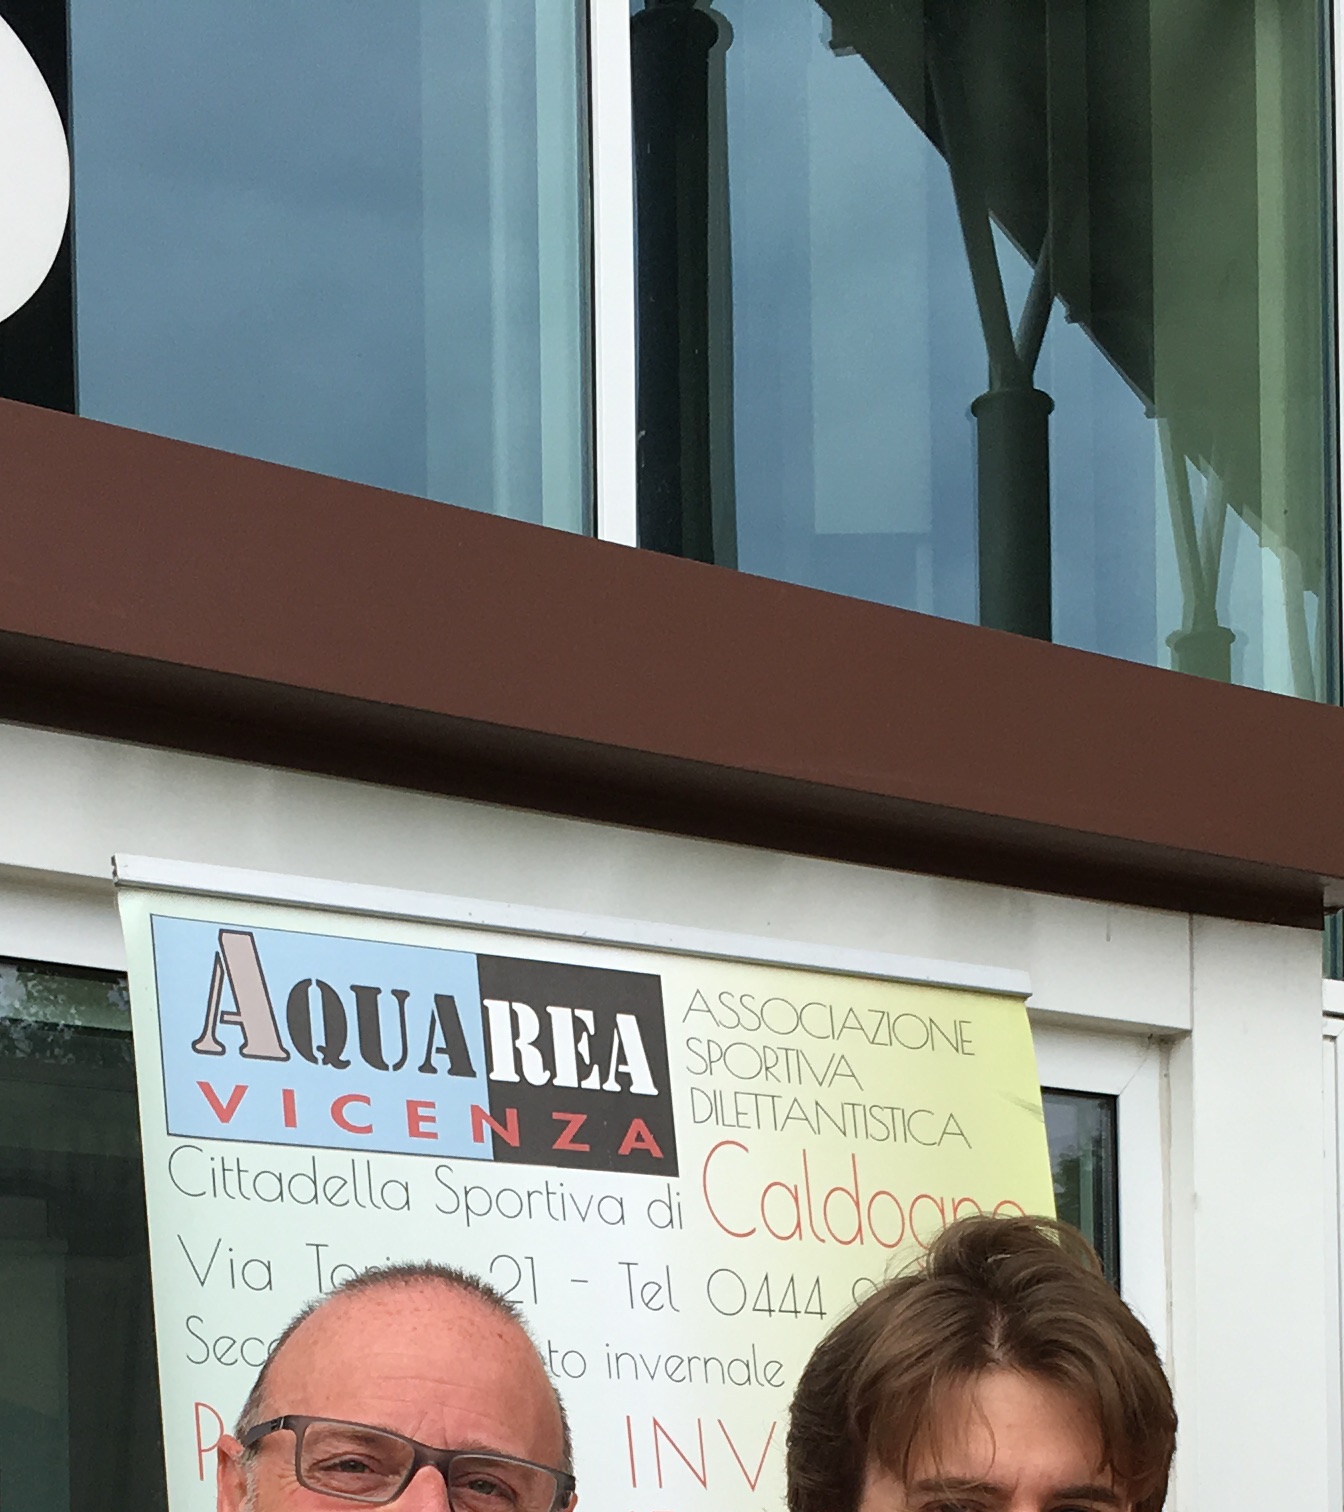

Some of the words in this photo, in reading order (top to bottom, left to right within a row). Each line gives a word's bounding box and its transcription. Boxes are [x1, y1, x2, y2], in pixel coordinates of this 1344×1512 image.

[192, 928, 659, 1096] AQUAREA
[681, 987, 976, 1057] ASSOCIAZIONE
[684, 1037, 864, 1092] SPORTIVA
[196, 1080, 664, 1159] VICENZA
[689, 1086, 973, 1150] DILETTANTISTICA
[167, 1144, 412, 1212] Cittadella
[434, 1164, 627, 1227] Sportiva
[646, 1182, 684, 1230] di
[176, 1233, 273, 1291] Via
[489, 1253, 539, 1305] 21
[617, 1261, 681, 1312] Tel
[706, 1267, 828, 1321] 0444
[604, 1343, 785, 1389] invernale
